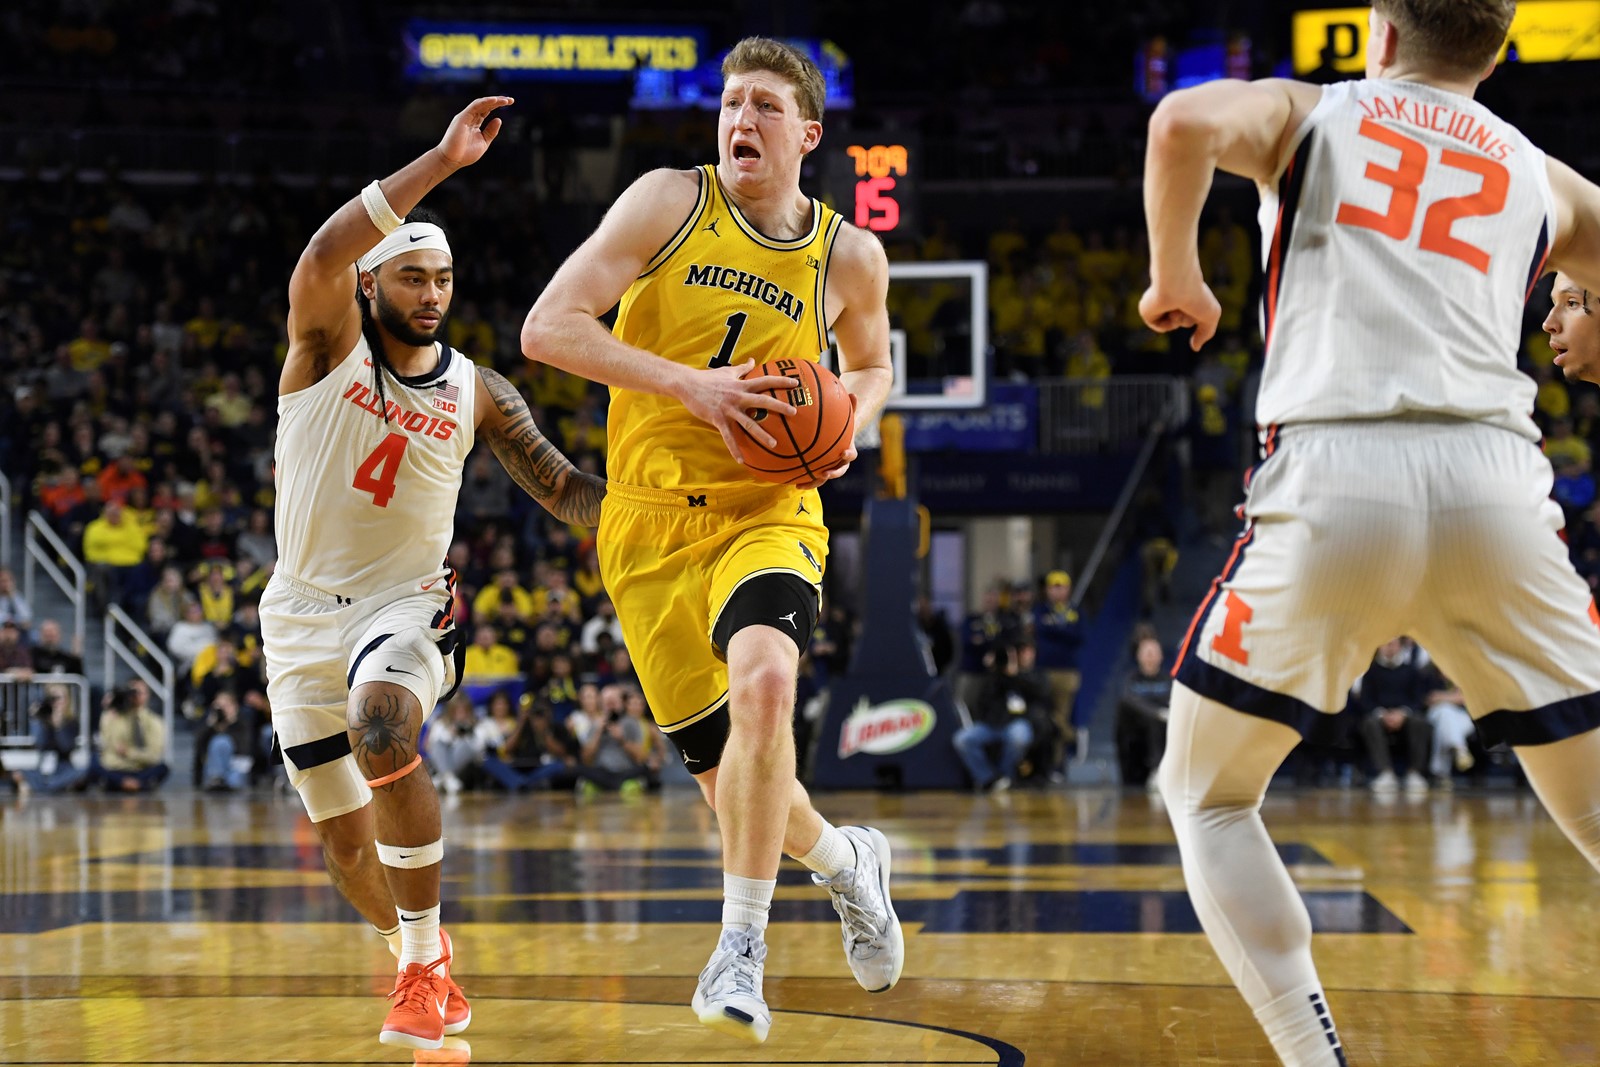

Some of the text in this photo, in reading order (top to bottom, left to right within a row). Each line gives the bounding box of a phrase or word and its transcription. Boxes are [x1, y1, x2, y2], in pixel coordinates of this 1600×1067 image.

[1358, 96, 1515, 160] JAKUCIONIS
[855, 177, 900, 232] 15
[1335, 117, 1510, 276] 32
[683, 264, 804, 324] MICHIGAN
[707, 311, 748, 369] 1
[343, 381, 457, 441] ILLINOIS
[433, 397, 457, 413] B1G
[352, 432, 409, 508] 4
[687, 495, 708, 508] M
